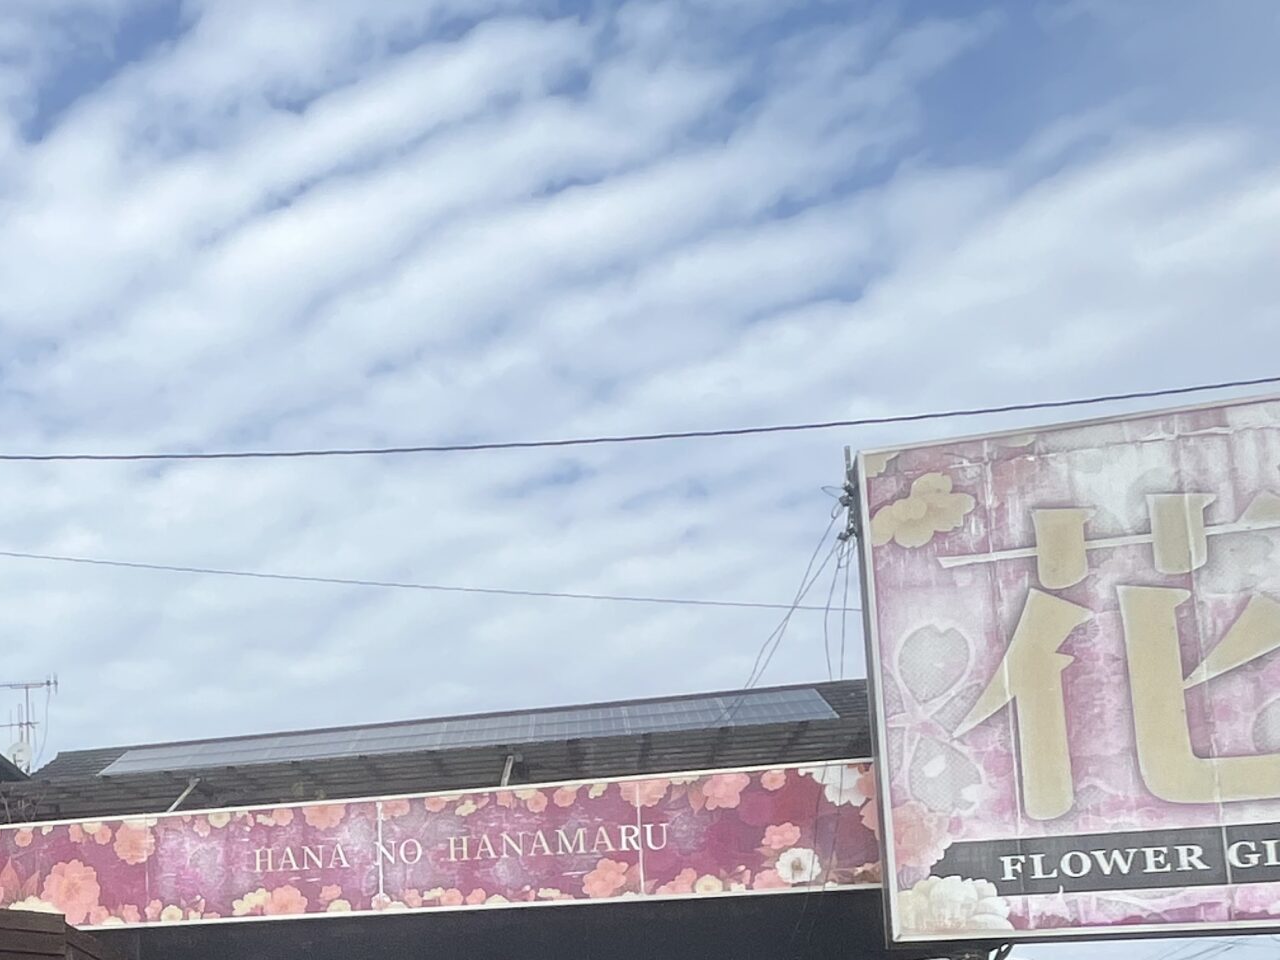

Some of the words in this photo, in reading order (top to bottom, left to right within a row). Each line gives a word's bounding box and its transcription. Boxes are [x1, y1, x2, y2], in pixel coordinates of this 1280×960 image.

[938, 490, 1280, 821] 花
[254, 843, 351, 874] HANA
[375, 838, 423, 866] NO
[447, 822, 669, 863] HANAMARU
[999, 843, 1211, 881] FLOWER
